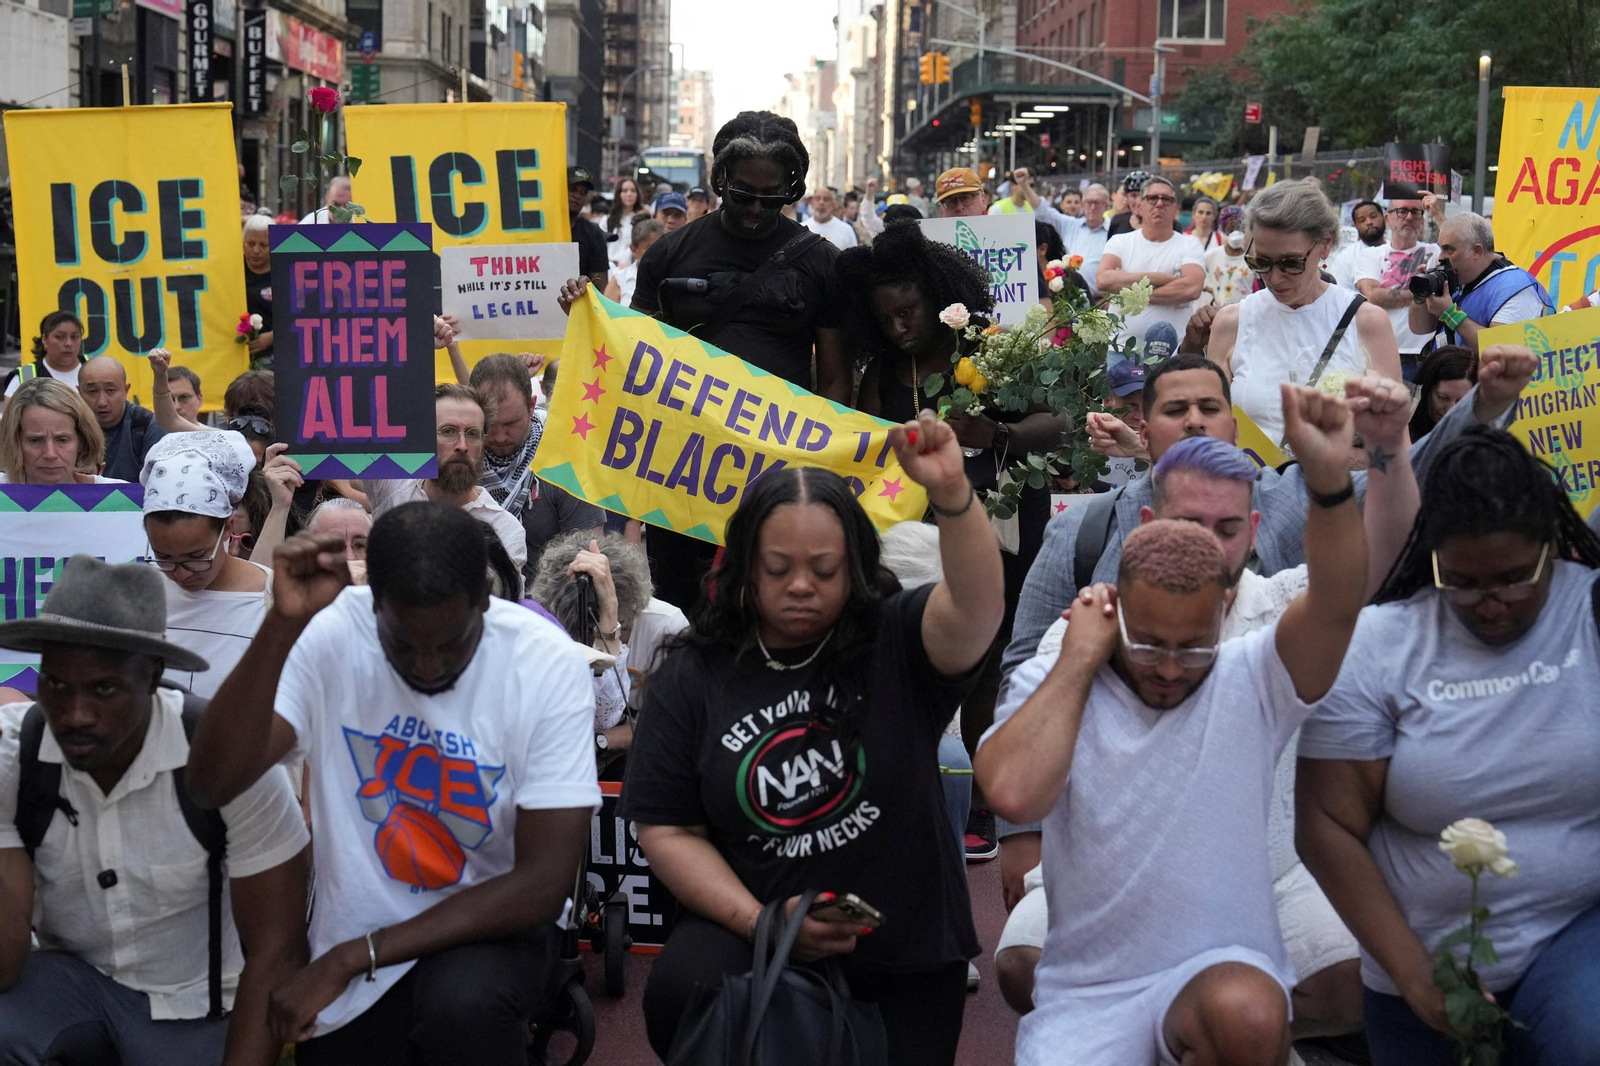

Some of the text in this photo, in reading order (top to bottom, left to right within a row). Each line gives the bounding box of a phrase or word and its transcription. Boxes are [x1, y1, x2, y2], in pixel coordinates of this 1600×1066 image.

[193, 3, 209, 98] GOURMET
[248, 26, 262, 112] BUFFET
[389, 148, 545, 239] ICE
[1390, 159, 1430, 172] FIGHT
[1390, 171, 1447, 186] FASCISM
[50, 177, 208, 267] ICE
[290, 259, 407, 313] FREE
[458, 280, 547, 294] WHILE IT'S STILL
[470, 255, 541, 277] THINK
[57, 274, 208, 357] OUT
[472, 300, 539, 320] LEGAL
[290, 317, 407, 368] THEM
[296, 374, 407, 443] ALL
[622, 340, 833, 452] DEFEND
[601, 406, 788, 505] BLACK
[1529, 420, 1582, 457] NEW
[721, 713, 761, 753] GET
[759, 690, 811, 725] YOUR
[756, 739, 844, 807] NAN
[816, 800, 881, 853] NECKS
